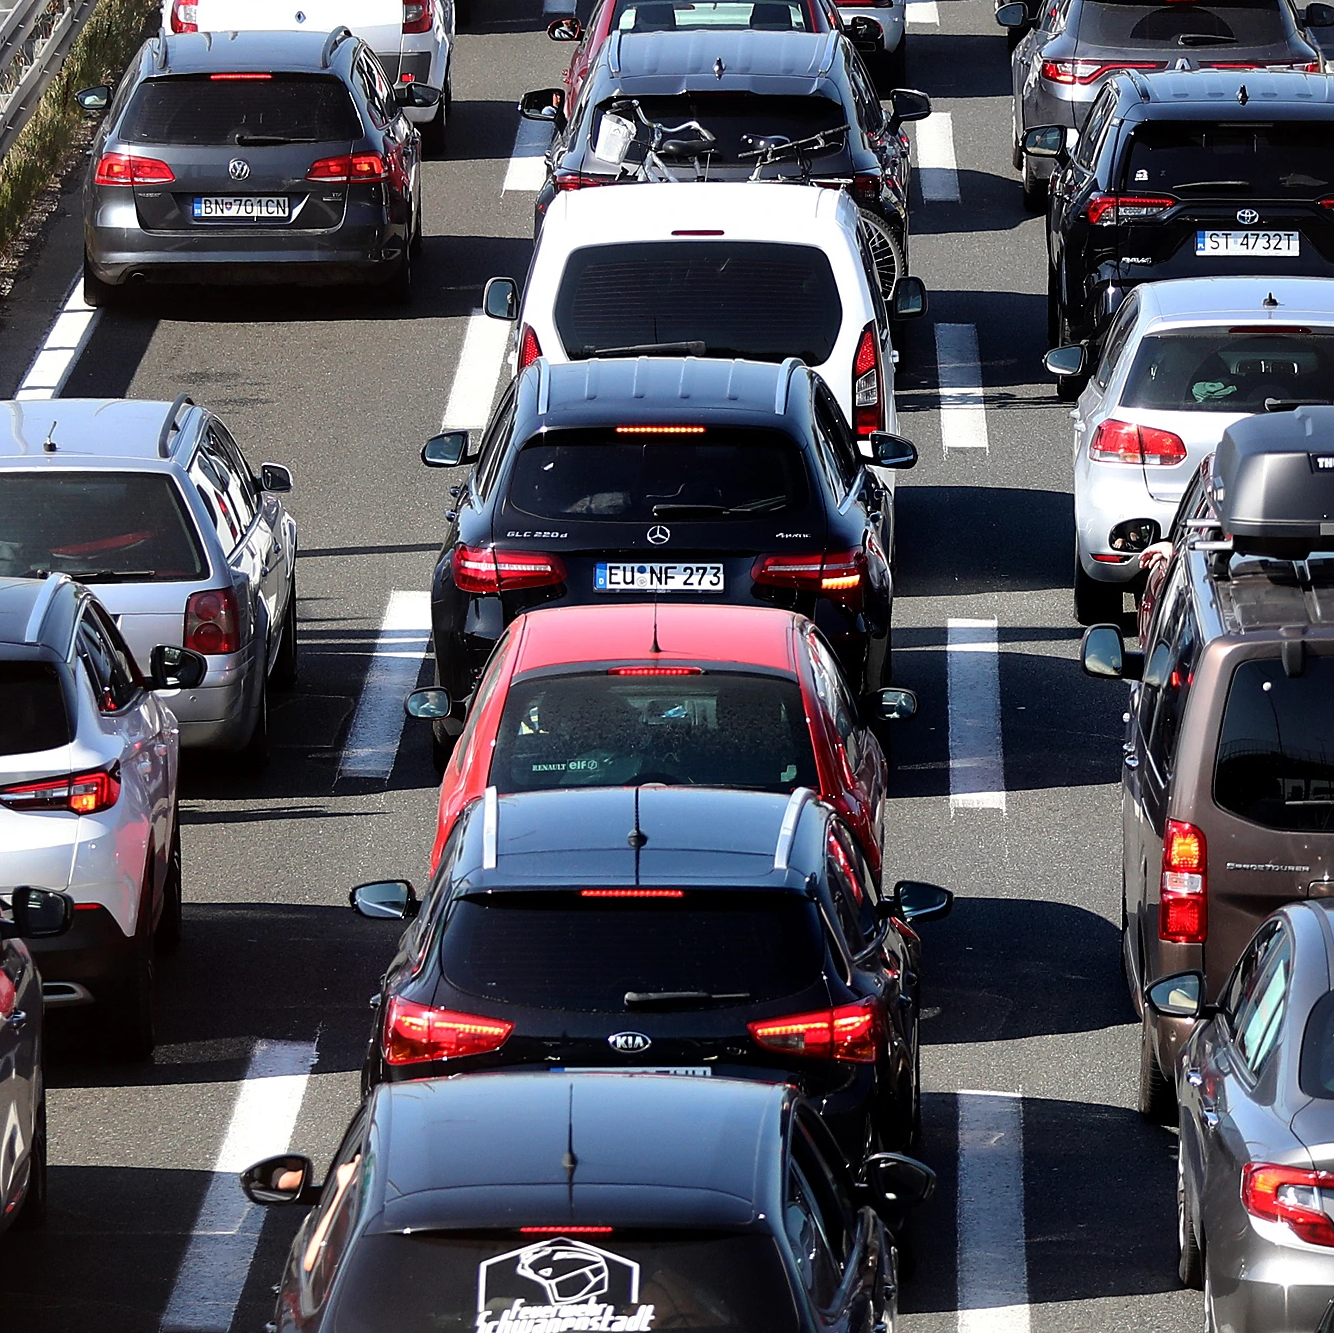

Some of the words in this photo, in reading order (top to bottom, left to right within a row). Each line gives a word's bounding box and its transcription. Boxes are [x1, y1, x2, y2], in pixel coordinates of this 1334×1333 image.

[203, 198, 224, 215] BN
[235, 197, 286, 214] 701CN
[1209, 233, 1231, 250] ST
[1240, 232, 1294, 250] 4732T
[533, 530, 568, 539] 220d
[608, 567, 635, 587] EU
[649, 566, 678, 586] NF
[683, 566, 721, 586] 273
[532, 763, 567, 771] RENAULT
[568, 759, 587, 770] elf
[616, 1036, 645, 1048] KIA
[510, 1296, 608, 1320] Feuerwehr
[475, 1304, 656, 1333] Schwanenstadt
